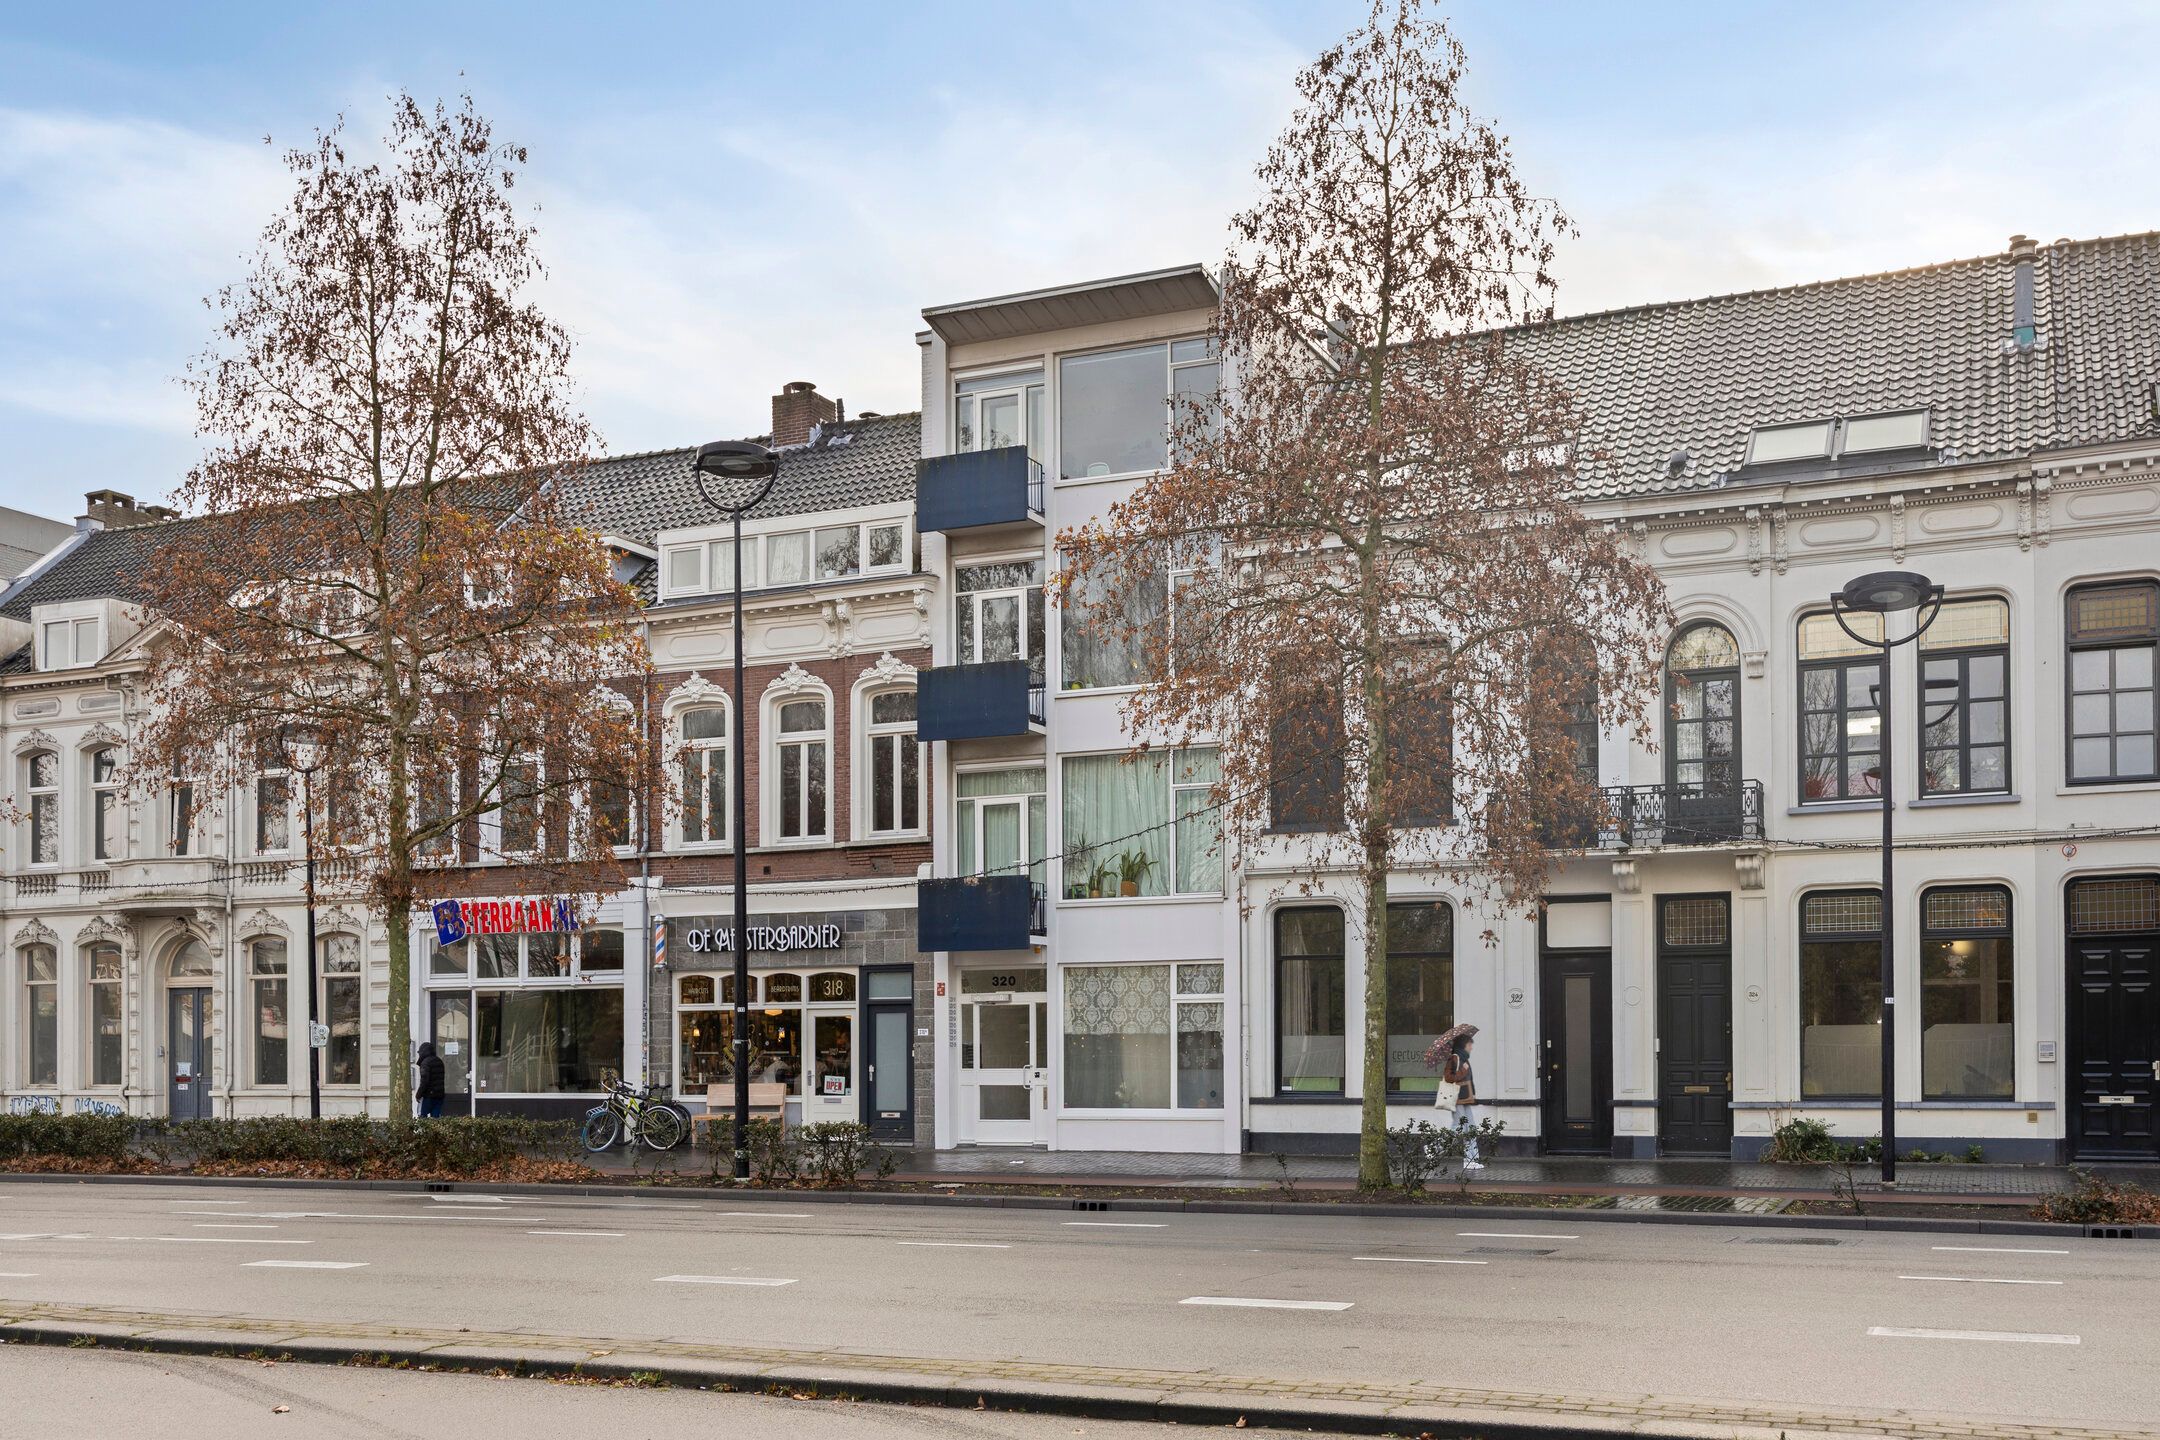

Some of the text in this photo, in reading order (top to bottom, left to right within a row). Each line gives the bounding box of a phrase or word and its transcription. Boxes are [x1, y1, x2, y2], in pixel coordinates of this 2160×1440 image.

[687, 924, 840, 952] DE MESTERBARBIER
[824, 980, 843, 996] 318
[992, 976, 1016, 987] 320
[826, 1081, 842, 1091] OPEN
